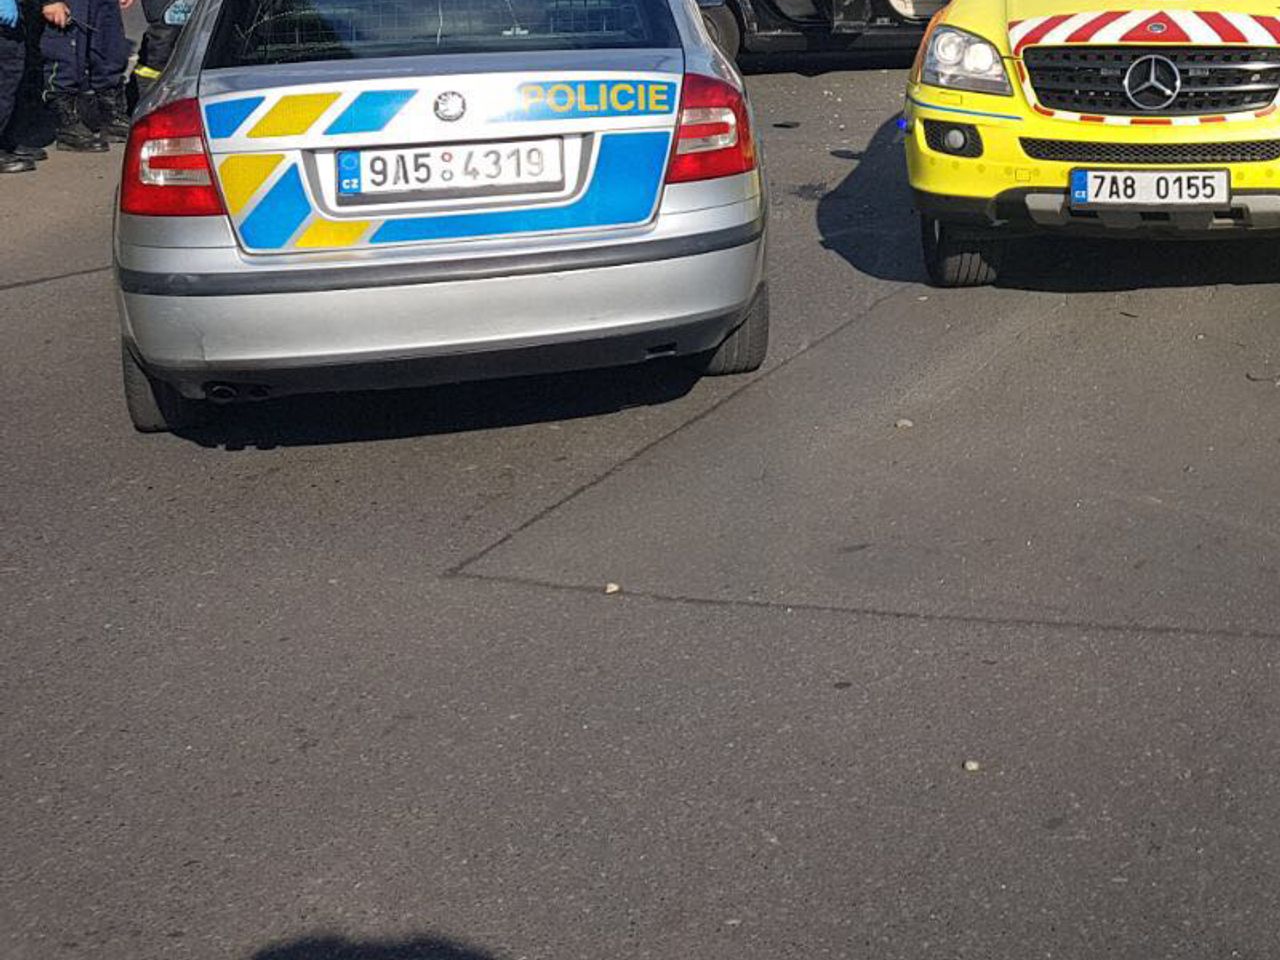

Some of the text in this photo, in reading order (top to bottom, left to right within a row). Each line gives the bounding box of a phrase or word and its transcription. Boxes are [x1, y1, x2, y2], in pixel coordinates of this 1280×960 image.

[518, 83, 669, 113] POLICIE
[369, 147, 545, 187] 9A5 4319
[1093, 175, 1216, 200] 7A8 0155
